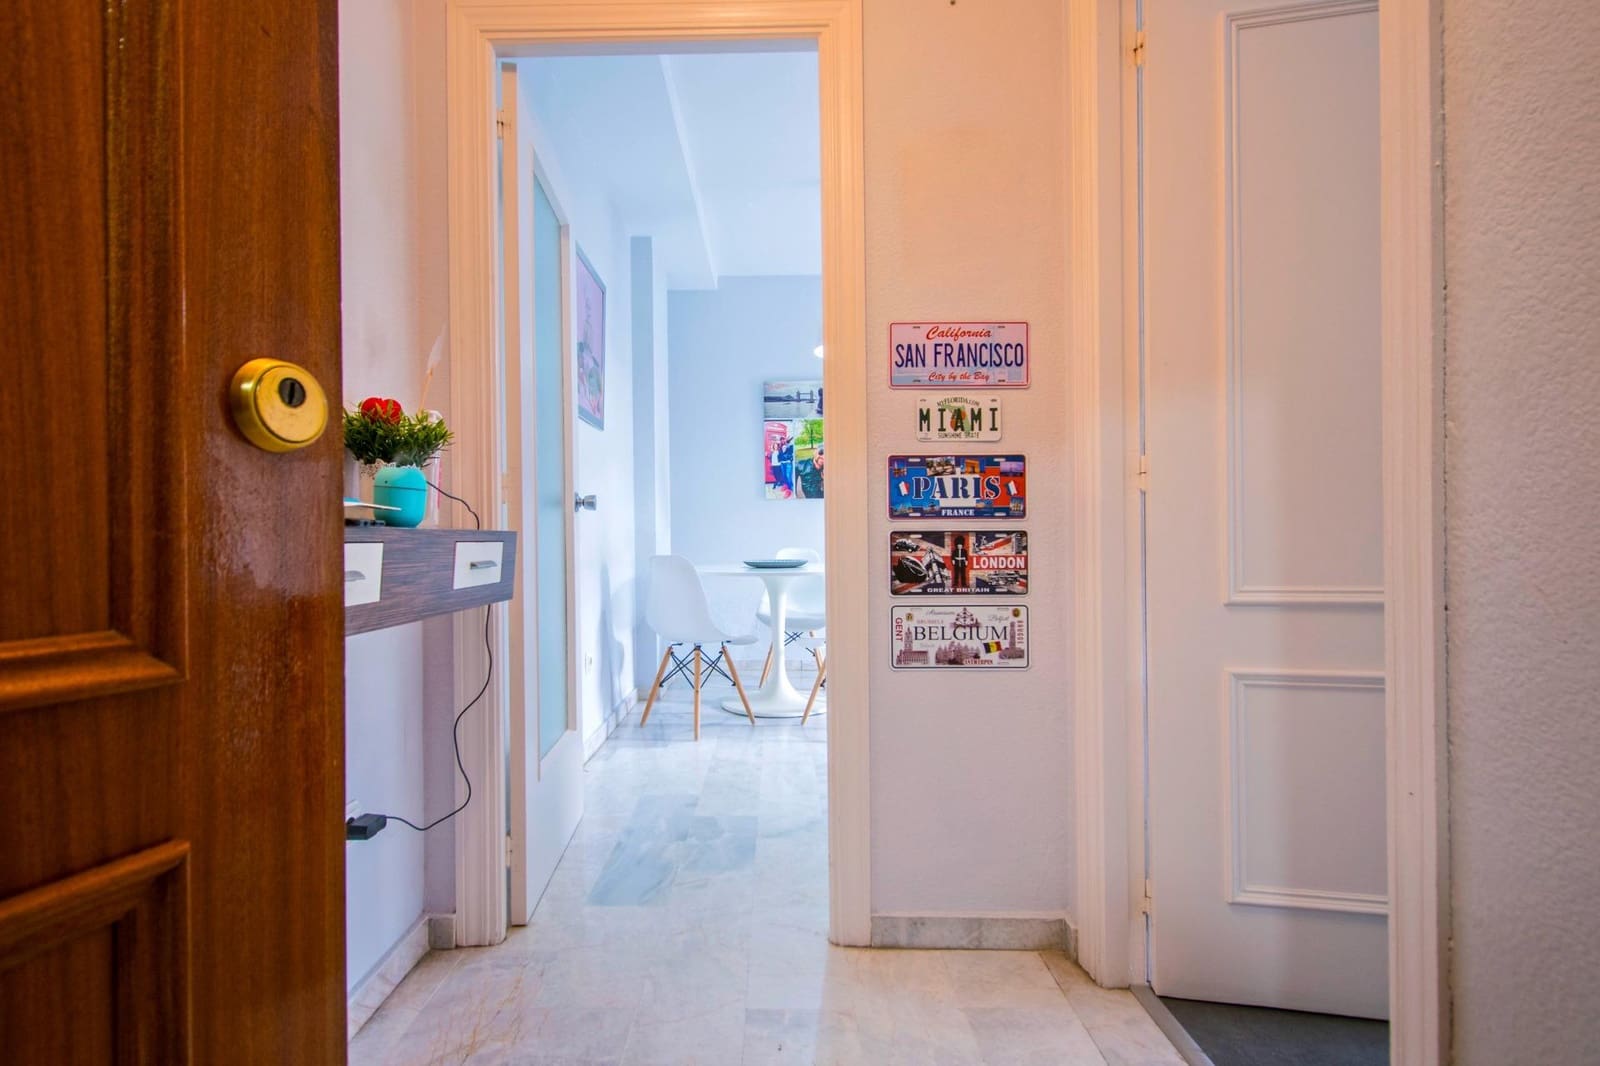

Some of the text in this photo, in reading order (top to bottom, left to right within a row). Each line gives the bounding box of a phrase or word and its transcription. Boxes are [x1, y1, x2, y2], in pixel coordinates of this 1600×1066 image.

[926, 326, 992, 341] California
[895, 343, 1024, 368] SAN FRANCISCO
[928, 371, 990, 382] City by the Bay
[919, 407, 998, 432] MIAMI
[912, 476, 1001, 500] PARIS
[941, 508, 975, 517] FRANCE
[973, 556, 1025, 569] LONDON
[895, 617, 904, 641] GENT
[914, 625, 1008, 641] BELGIUM
